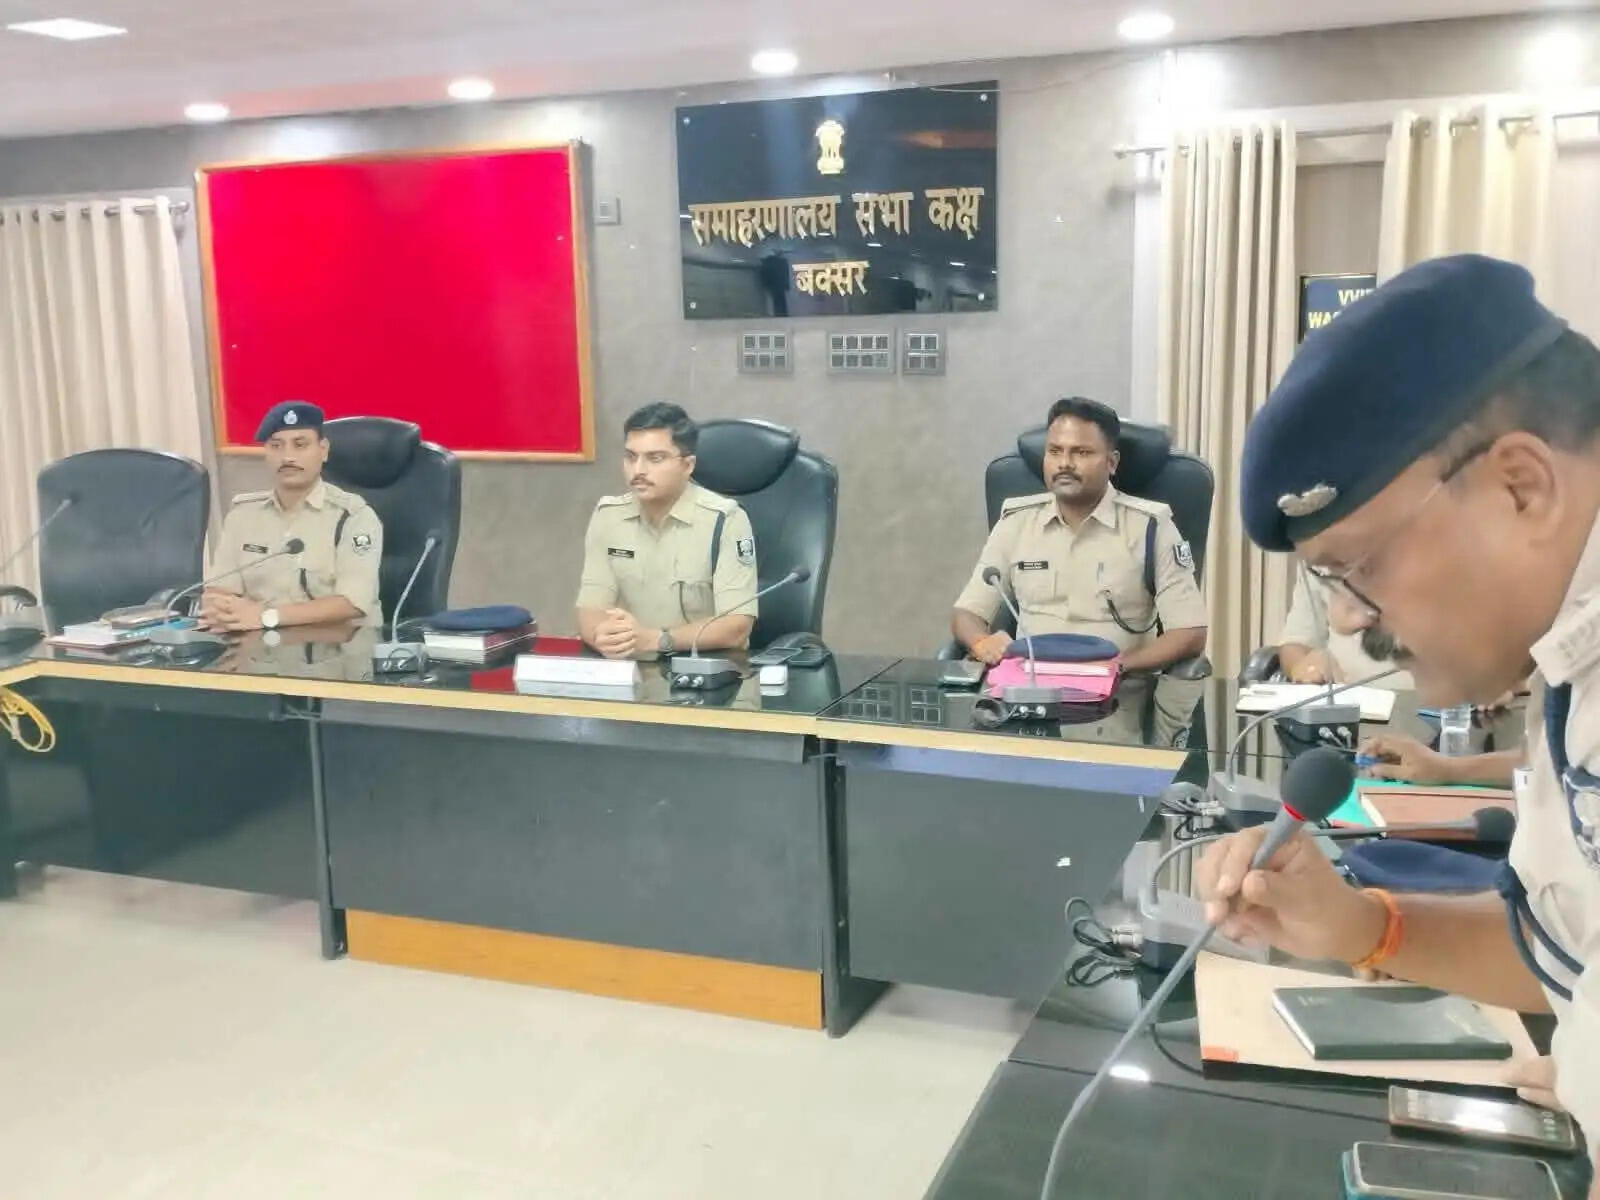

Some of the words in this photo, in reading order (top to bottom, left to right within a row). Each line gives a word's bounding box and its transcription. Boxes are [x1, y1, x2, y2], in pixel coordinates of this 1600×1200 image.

[687, 195, 841, 248] समाहरणालय
[852, 191, 914, 237] सभा
[925, 187, 984, 241] कक्ष
[792, 260, 870, 296] बक्सर
